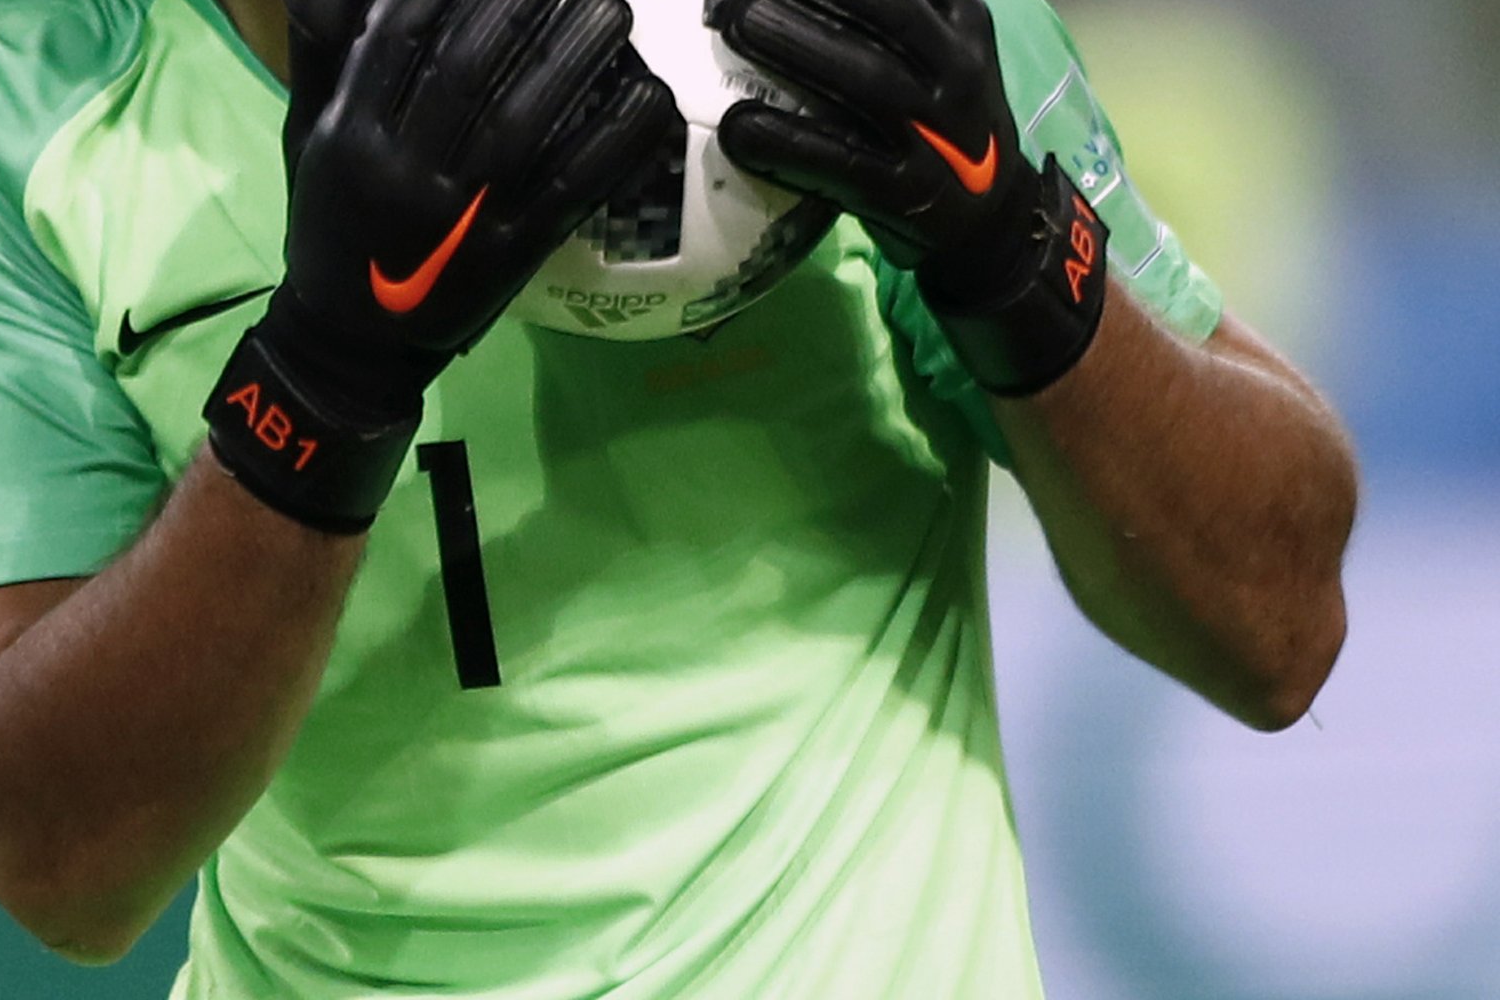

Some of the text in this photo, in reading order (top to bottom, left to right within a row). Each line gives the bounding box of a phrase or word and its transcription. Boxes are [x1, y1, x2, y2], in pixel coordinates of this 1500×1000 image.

[547, 285, 667, 309] adidas
[1064, 194, 1097, 304] AB1
[416, 439, 502, 690] 1
